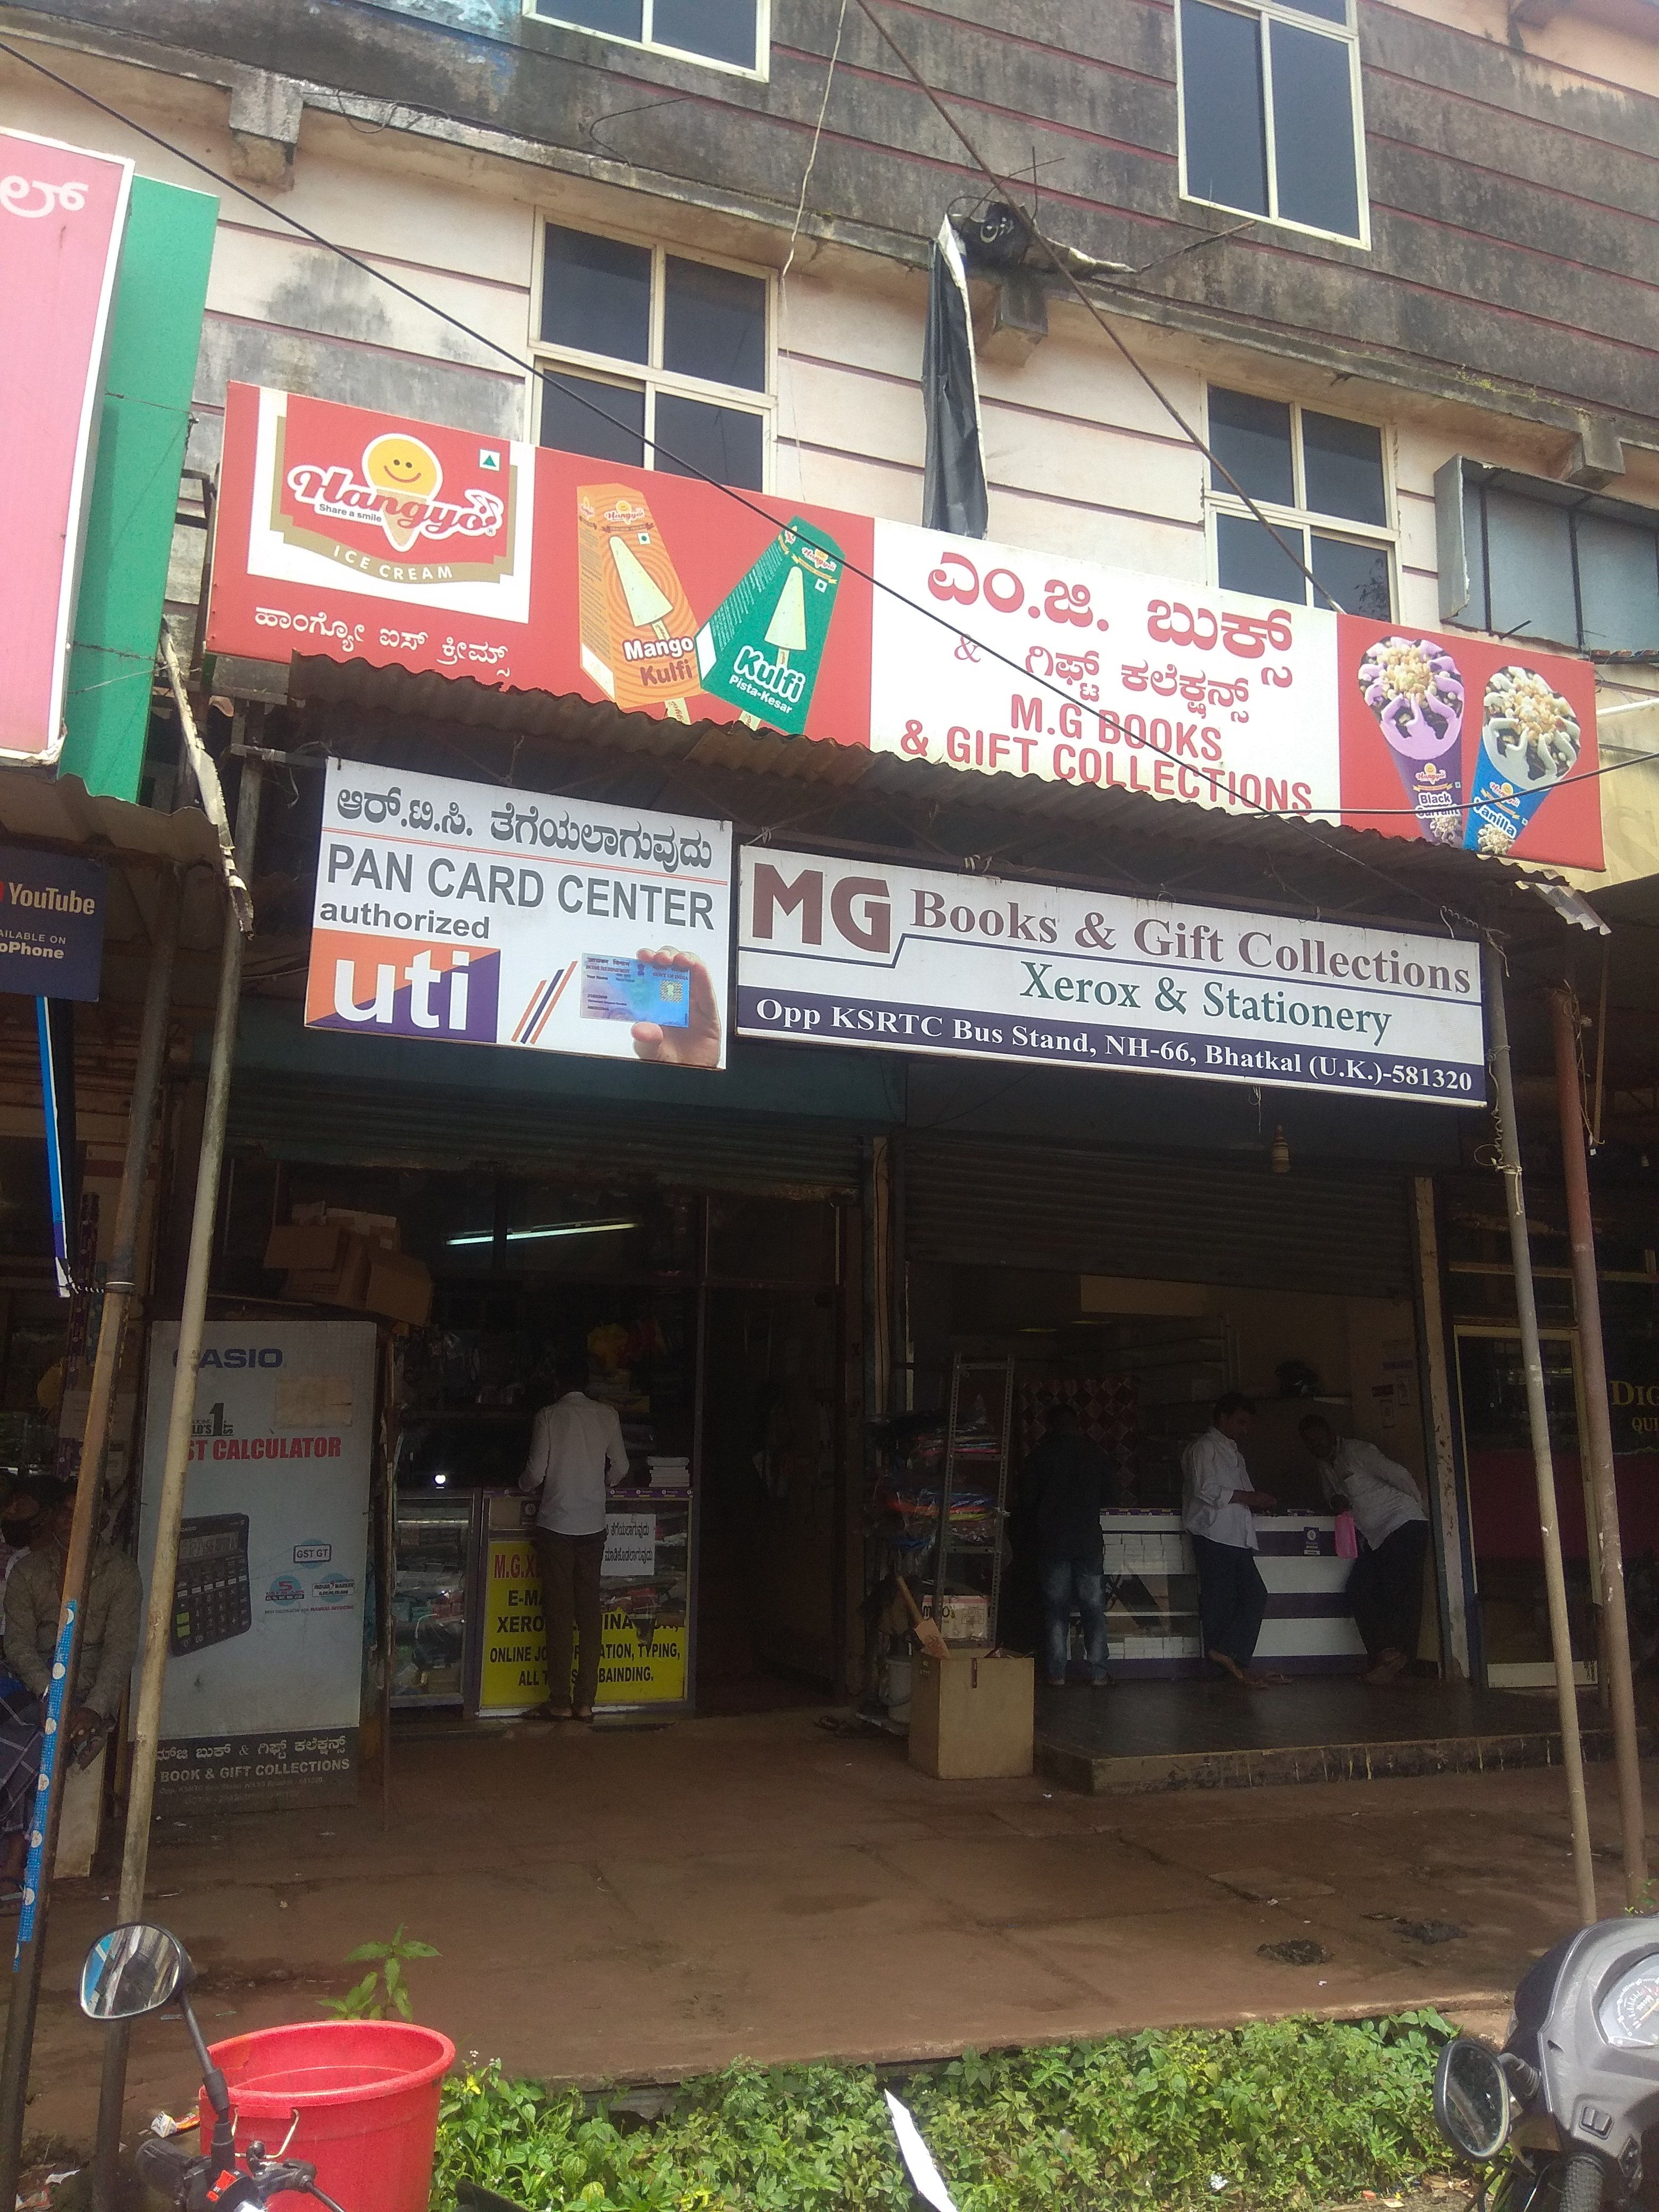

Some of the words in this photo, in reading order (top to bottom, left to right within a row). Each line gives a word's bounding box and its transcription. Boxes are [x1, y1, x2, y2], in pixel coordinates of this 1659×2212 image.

[288, 465, 504, 536] Hangyo
[319, 503, 347, 516] Share
[357, 512, 382, 523] smile
[333, 545, 370, 570] ICE
[379, 564, 453, 581] CREAM
[928, 552, 1109, 632] ಎಂ.ಜಿ.
[1147, 599, 1293, 688] ಬುಕ್ಸ್
[379, 626, 429, 651] ಐಸ್
[624, 637, 693, 660] Mango
[954, 634, 981, 663] &
[640, 659, 692, 686] Kulfi
[734, 646, 806, 703] Kulfi
[730, 675, 793, 714] Pista-Kesar
[1011, 694, 1083, 740] M.G
[1099, 709, 1222, 761] BOOKS
[901, 720, 928, 756] &
[947, 726, 1038, 773] GIFT
[1053, 744, 1312, 816] COLLECTIONS
[1419, 792, 1452, 805] Black
[490, 802, 713, 874] ತೆಗೆಯಲಾಗುವುದು
[9, 882, 95, 915] YouTube
[327, 843, 413, 893] PAN
[428, 857, 544, 909] CARD
[558, 873, 715, 931] CENTER
[319, 900, 490, 940] authorized
[752, 862, 891, 954] MG
[910, 889, 1058, 944] Books
[1075, 912, 1117, 950] &
[1133, 918, 1224, 963] Gift
[1238, 931, 1471, 995] Collections
[0, 941, 64, 959] oPhone
[50, 936, 66, 944] ON
[333, 949, 471, 1031] uti
[1020, 960, 1141, 1009] Xerox
[1154, 976, 1187, 1016] &
[1203, 981, 1393, 1046] Stationery
[756, 998, 820, 1030] Opp
[830, 1006, 943, 1037] KSRTC
[953, 1019, 1003, 1044] Bus
[1012, 1025, 1097, 1058] Stand,
[1104, 1034, 1197, 1066] NH-66,
[1205, 1044, 1302, 1074] Bhatkal
[1309, 1055, 1472, 1091] (U.K.)-581320
[172, 1347, 283, 1368] ASIO
[210, 1402, 224, 1436] 1
[213, 1437, 341, 1461] CALCULATOR
[297, 1549, 314, 1558] GST
[316, 1548, 328, 1557] GT
[490, 1646, 531, 1663] ONLINE
[518, 1670, 539, 1686] ALL
[239, 1745, 249, 1756] &
[161, 1769, 200, 1782] BOOK
[205, 1768, 215, 1780] &
[220, 1766, 251, 1779] GIFT
[255, 1758, 350, 1776] COLLECTIONS
